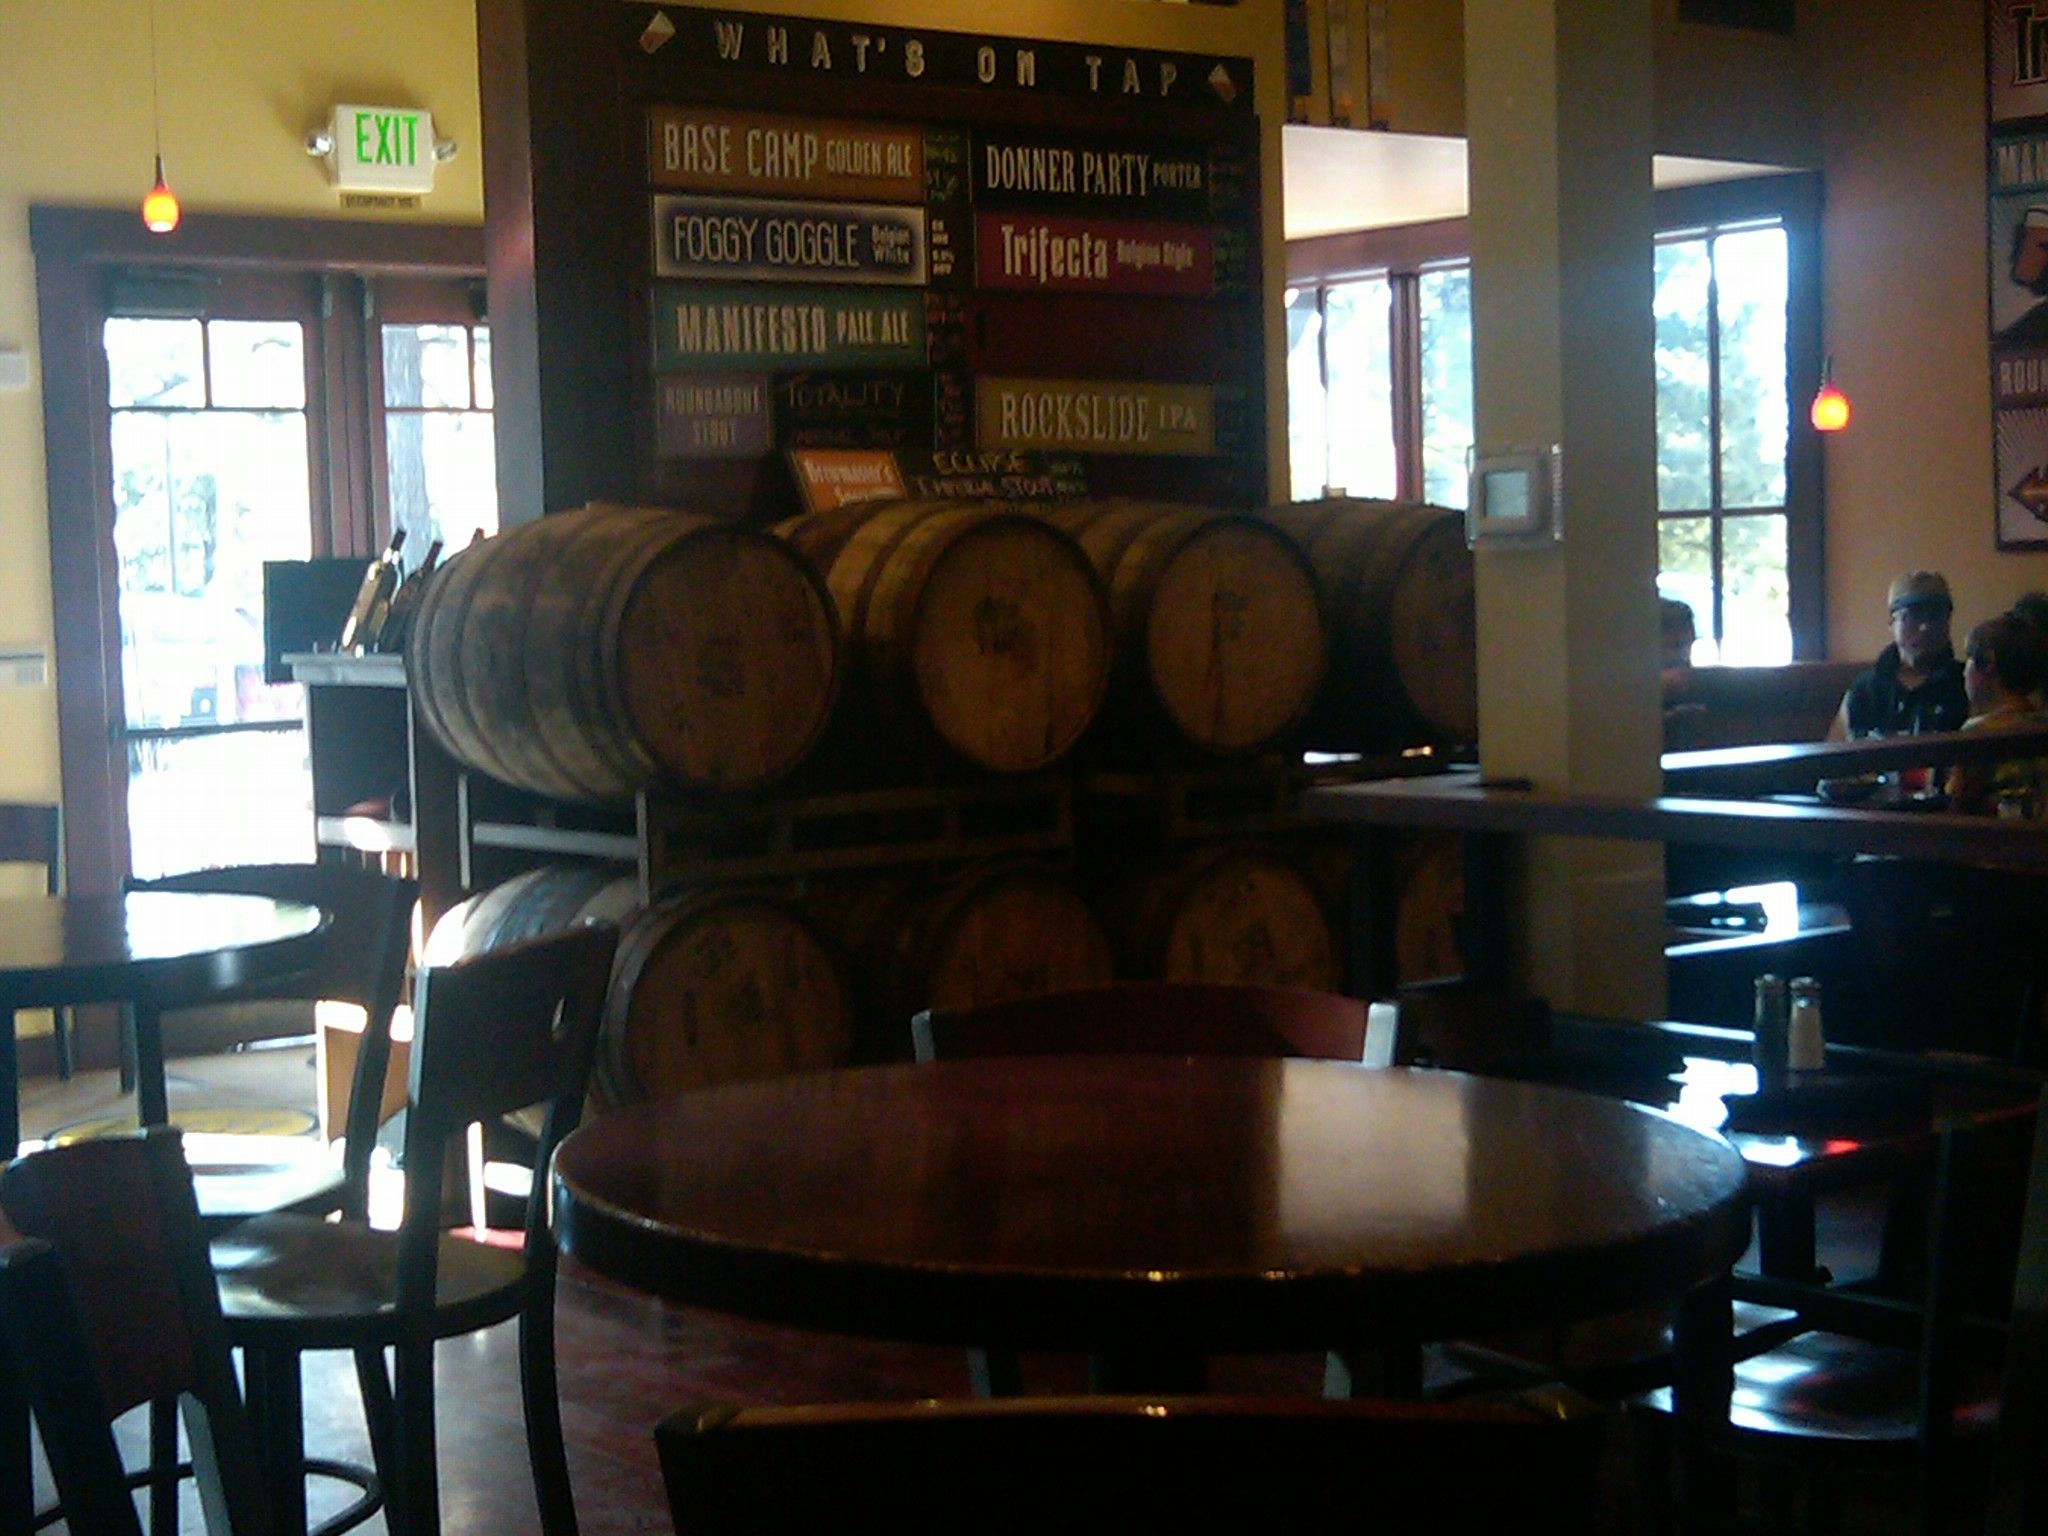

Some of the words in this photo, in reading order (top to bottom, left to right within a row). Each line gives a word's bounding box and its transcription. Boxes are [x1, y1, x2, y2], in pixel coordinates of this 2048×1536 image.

[715, 21, 925, 78] WHAT'S
[977, 46, 1036, 87] ON
[1085, 55, 1178, 97] TAP
[355, 112, 421, 167] EXIT
[663, 122, 732, 176] BASE
[746, 128, 818, 180] CAMP
[825, 138, 882, 177] GOLDEN
[886, 142, 913, 178] ALE
[985, 145, 1077, 194] DONNER
[1082, 152, 1150, 197] PARTY
[673, 215, 760, 263] FOGGY
[764, 218, 861, 268] GOGGLE
[1001, 223, 1109, 285] Trifecta
[676, 304, 826, 353] MANIFESTO
[836, 311, 874, 346] PALE
[880, 311, 910, 345] ALE
[1001, 390, 1150, 442] ROCKSLIDE
